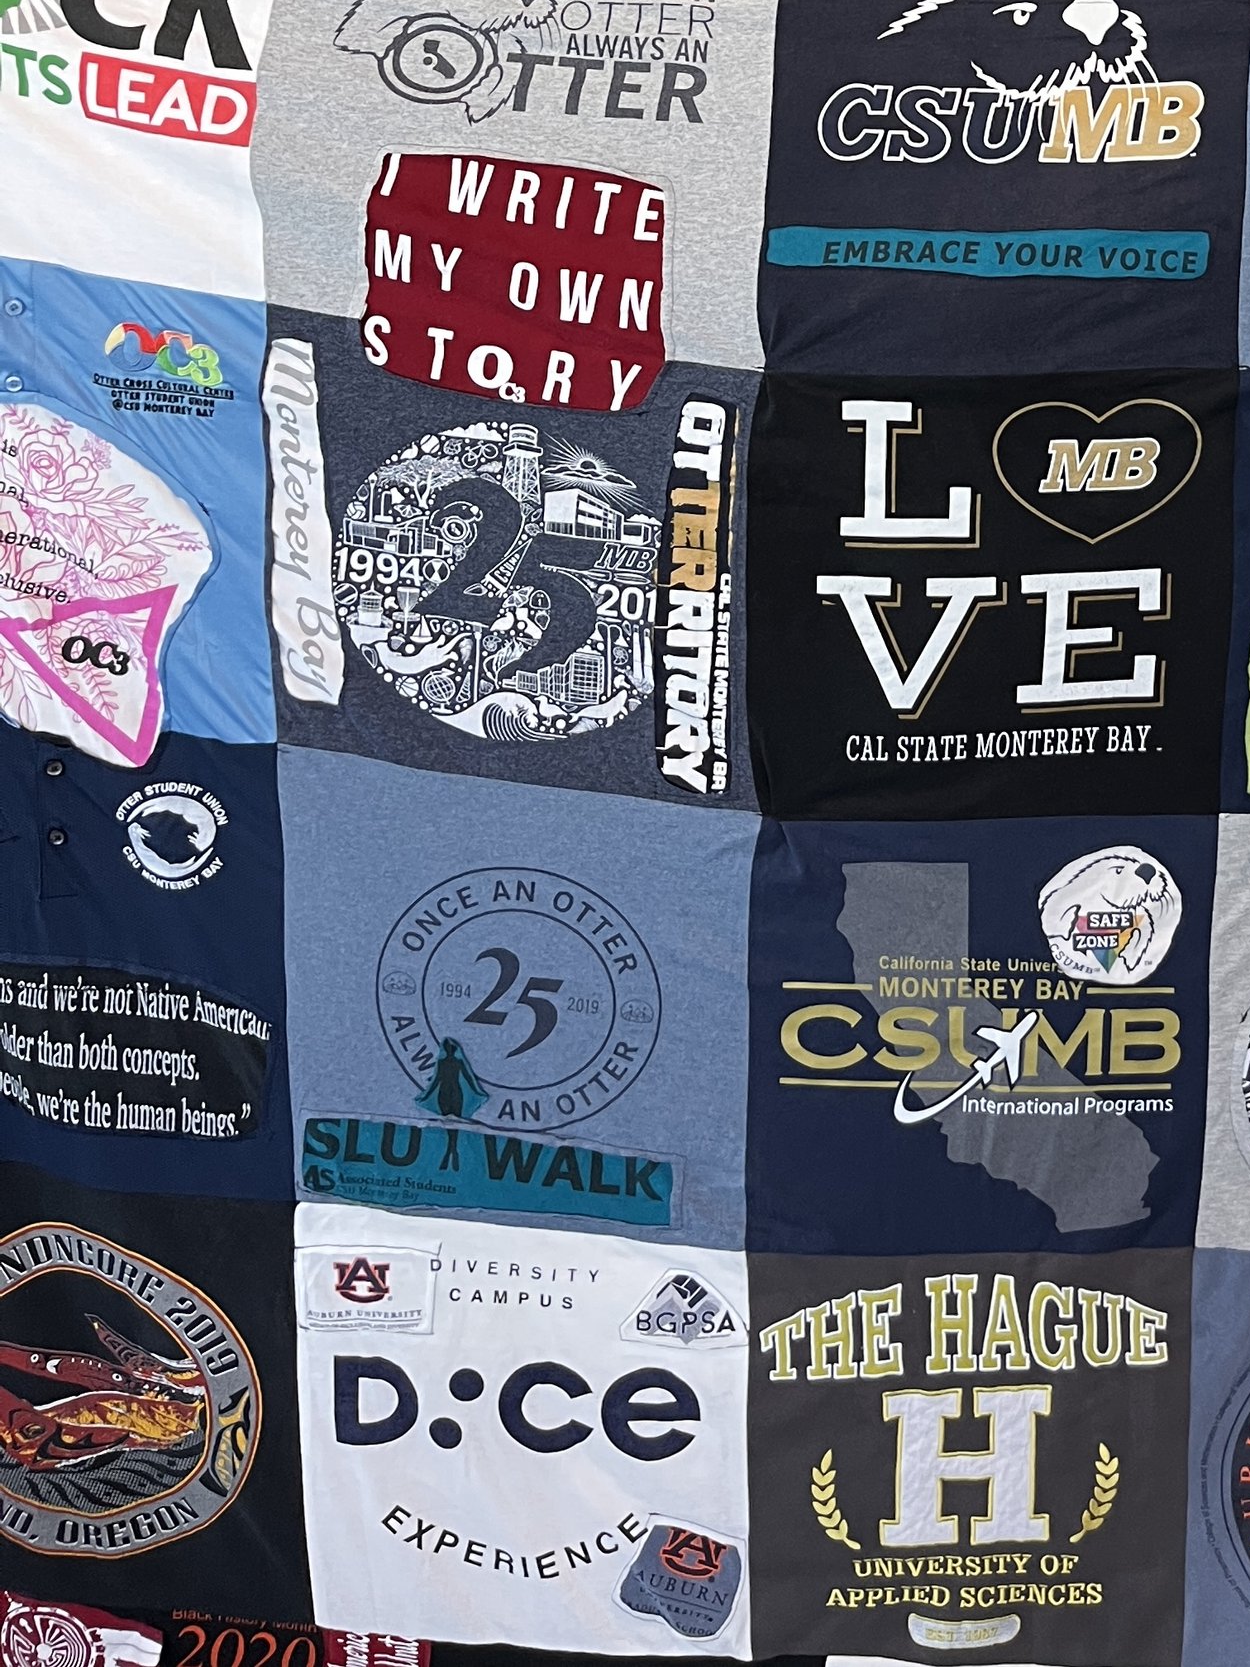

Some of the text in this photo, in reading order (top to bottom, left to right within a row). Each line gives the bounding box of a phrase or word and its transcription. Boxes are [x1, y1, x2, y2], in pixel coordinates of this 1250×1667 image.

[560, 2, 716, 38] OTTER
[566, 34, 709, 64] ALWAYS AN
[85, 62, 249, 137] LEAD
[816, 80, 1206, 165] CSUMB
[379, 153, 665, 242] I WRITE
[823, 240, 1199, 275] EMBRACE YOUR VOICE
[373, 229, 655, 333] MY OWN
[364, 315, 643, 413] STORY
[1039, 437, 1161, 494] MB
[269, 340, 330, 695] Monterey Bay
[337, 548, 425, 587] 1994
[710, 573, 731, 795] CAL STATE MONTEREY BA
[846, 725, 1152, 763] CAL STATE MONTEREY BAY
[116, 782, 229, 826] OTTER STUDENT UNION
[122, 845, 224, 890] CSU MONTEREY BAY
[403, 880, 638, 976] ONCE AN OTTER
[1075, 935, 1119, 949] ZONE
[1089, 913, 1131, 928] SAFE
[879, 955, 1001, 974] California State
[1050, 943, 1094, 975] CSUMB
[18, 972, 48, 1010] and
[102, 984, 134, 1016] not
[136, 982, 190, 1021] Native
[439, 981, 473, 1000] 1994
[463, 947, 565, 1059] 25
[566, 995, 600, 1016] 2019
[880, 977, 1085, 1001] MONTEREY BAY
[37, 1030, 200, 1086] than both concepts.
[780, 1002, 1182, 1077] CSUMB
[497, 1039, 639, 1123] AN OTTER
[36, 1088, 177, 1132] we're the human
[962, 1095, 1175, 1119] International Programs
[405, 1176, 457, 1195] Students
[482, 1133, 665, 1203] WALK
[429, 1258, 600, 1284] DIVERSITY
[307, 1309, 423, 1319] AUBURN UNIVERSITY
[448, 1287, 574, 1311] CAMPUS
[163, 1296, 240, 1378] 2019
[636, 1309, 737, 1335] BGPSA
[759, 1273, 1169, 1382] THE HAGUE
[878, 1384, 1053, 1547] H
[55, 1497, 200, 1550] OREGON
[380, 1504, 649, 1580] EXPERIENCE
[852, 1552, 1080, 1578] UNIVERSITY OF
[635, 1570, 729, 1607] AUBURN
[825, 1582, 1104, 1608] APPLIED SCIENCES
[175, 1624, 317, 1667] 2020
